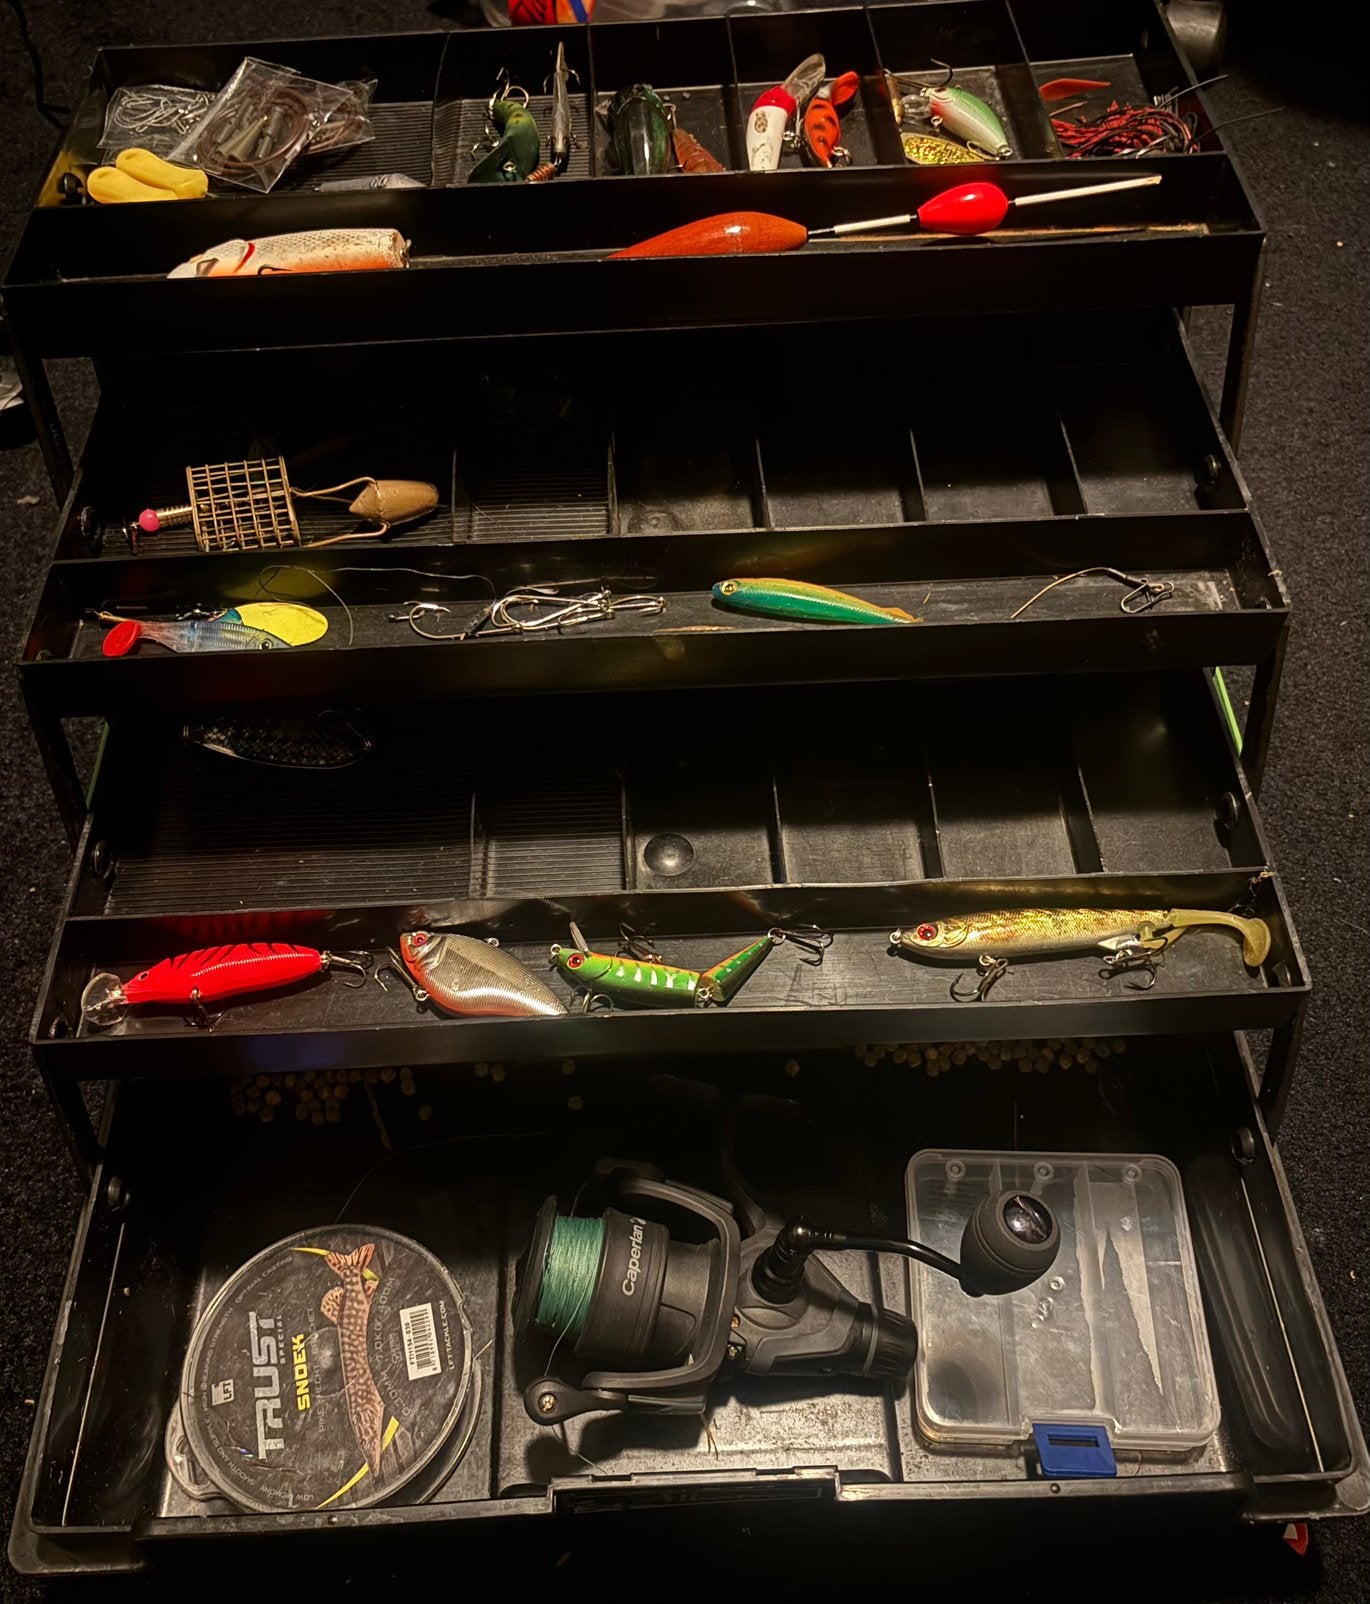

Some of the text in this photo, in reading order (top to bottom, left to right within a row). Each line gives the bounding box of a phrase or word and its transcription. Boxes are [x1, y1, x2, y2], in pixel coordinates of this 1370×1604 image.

[622, 1223, 644, 1296] Caperlan
[276, 1314, 286, 1364] SPECIAL
[292, 1334, 311, 1411] SNOEK
[223, 1382, 232, 1401] LFT
[249, 1311, 285, 1459] TRUST
